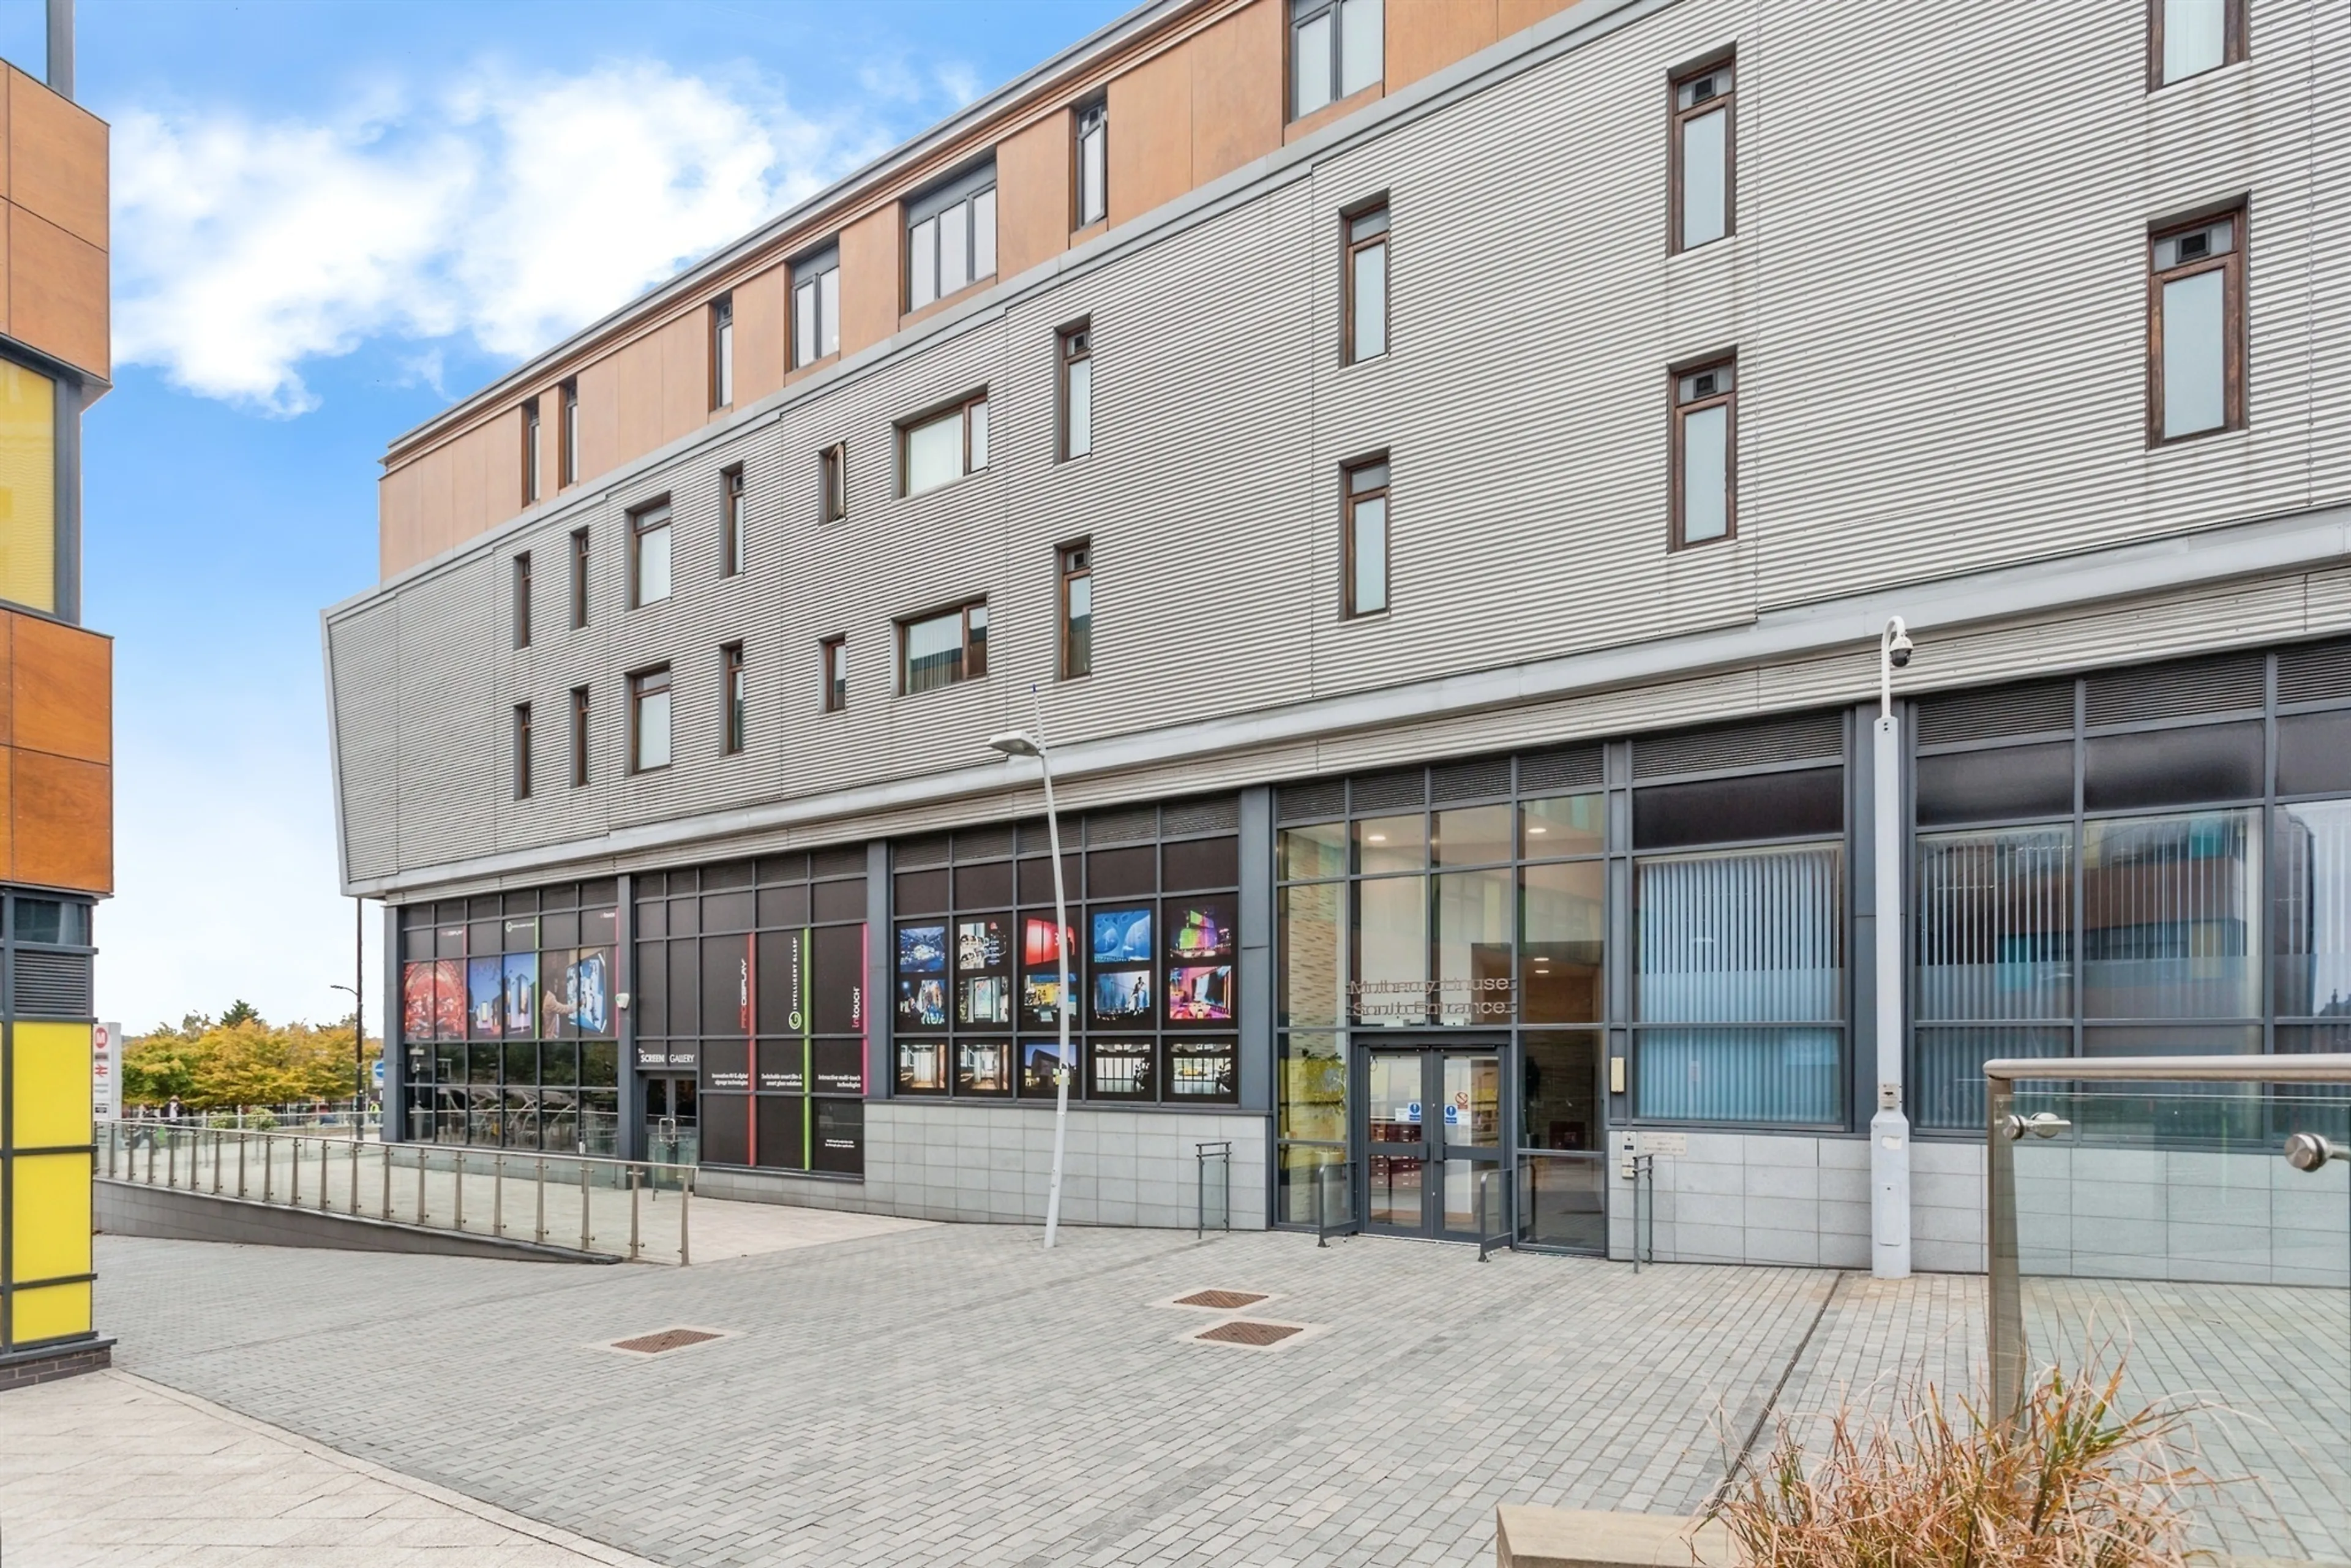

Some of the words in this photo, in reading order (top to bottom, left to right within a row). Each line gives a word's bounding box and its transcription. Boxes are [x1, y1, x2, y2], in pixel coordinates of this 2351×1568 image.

[1350, 980, 1436, 997] Mulberry
[1442, 977, 1509, 991] House
[1352, 1002, 1409, 1016] South
[1414, 1001, 1505, 1015] Entrance
[640, 1054, 665, 1063] SCREEN
[669, 1053, 695, 1063] GALLERY
